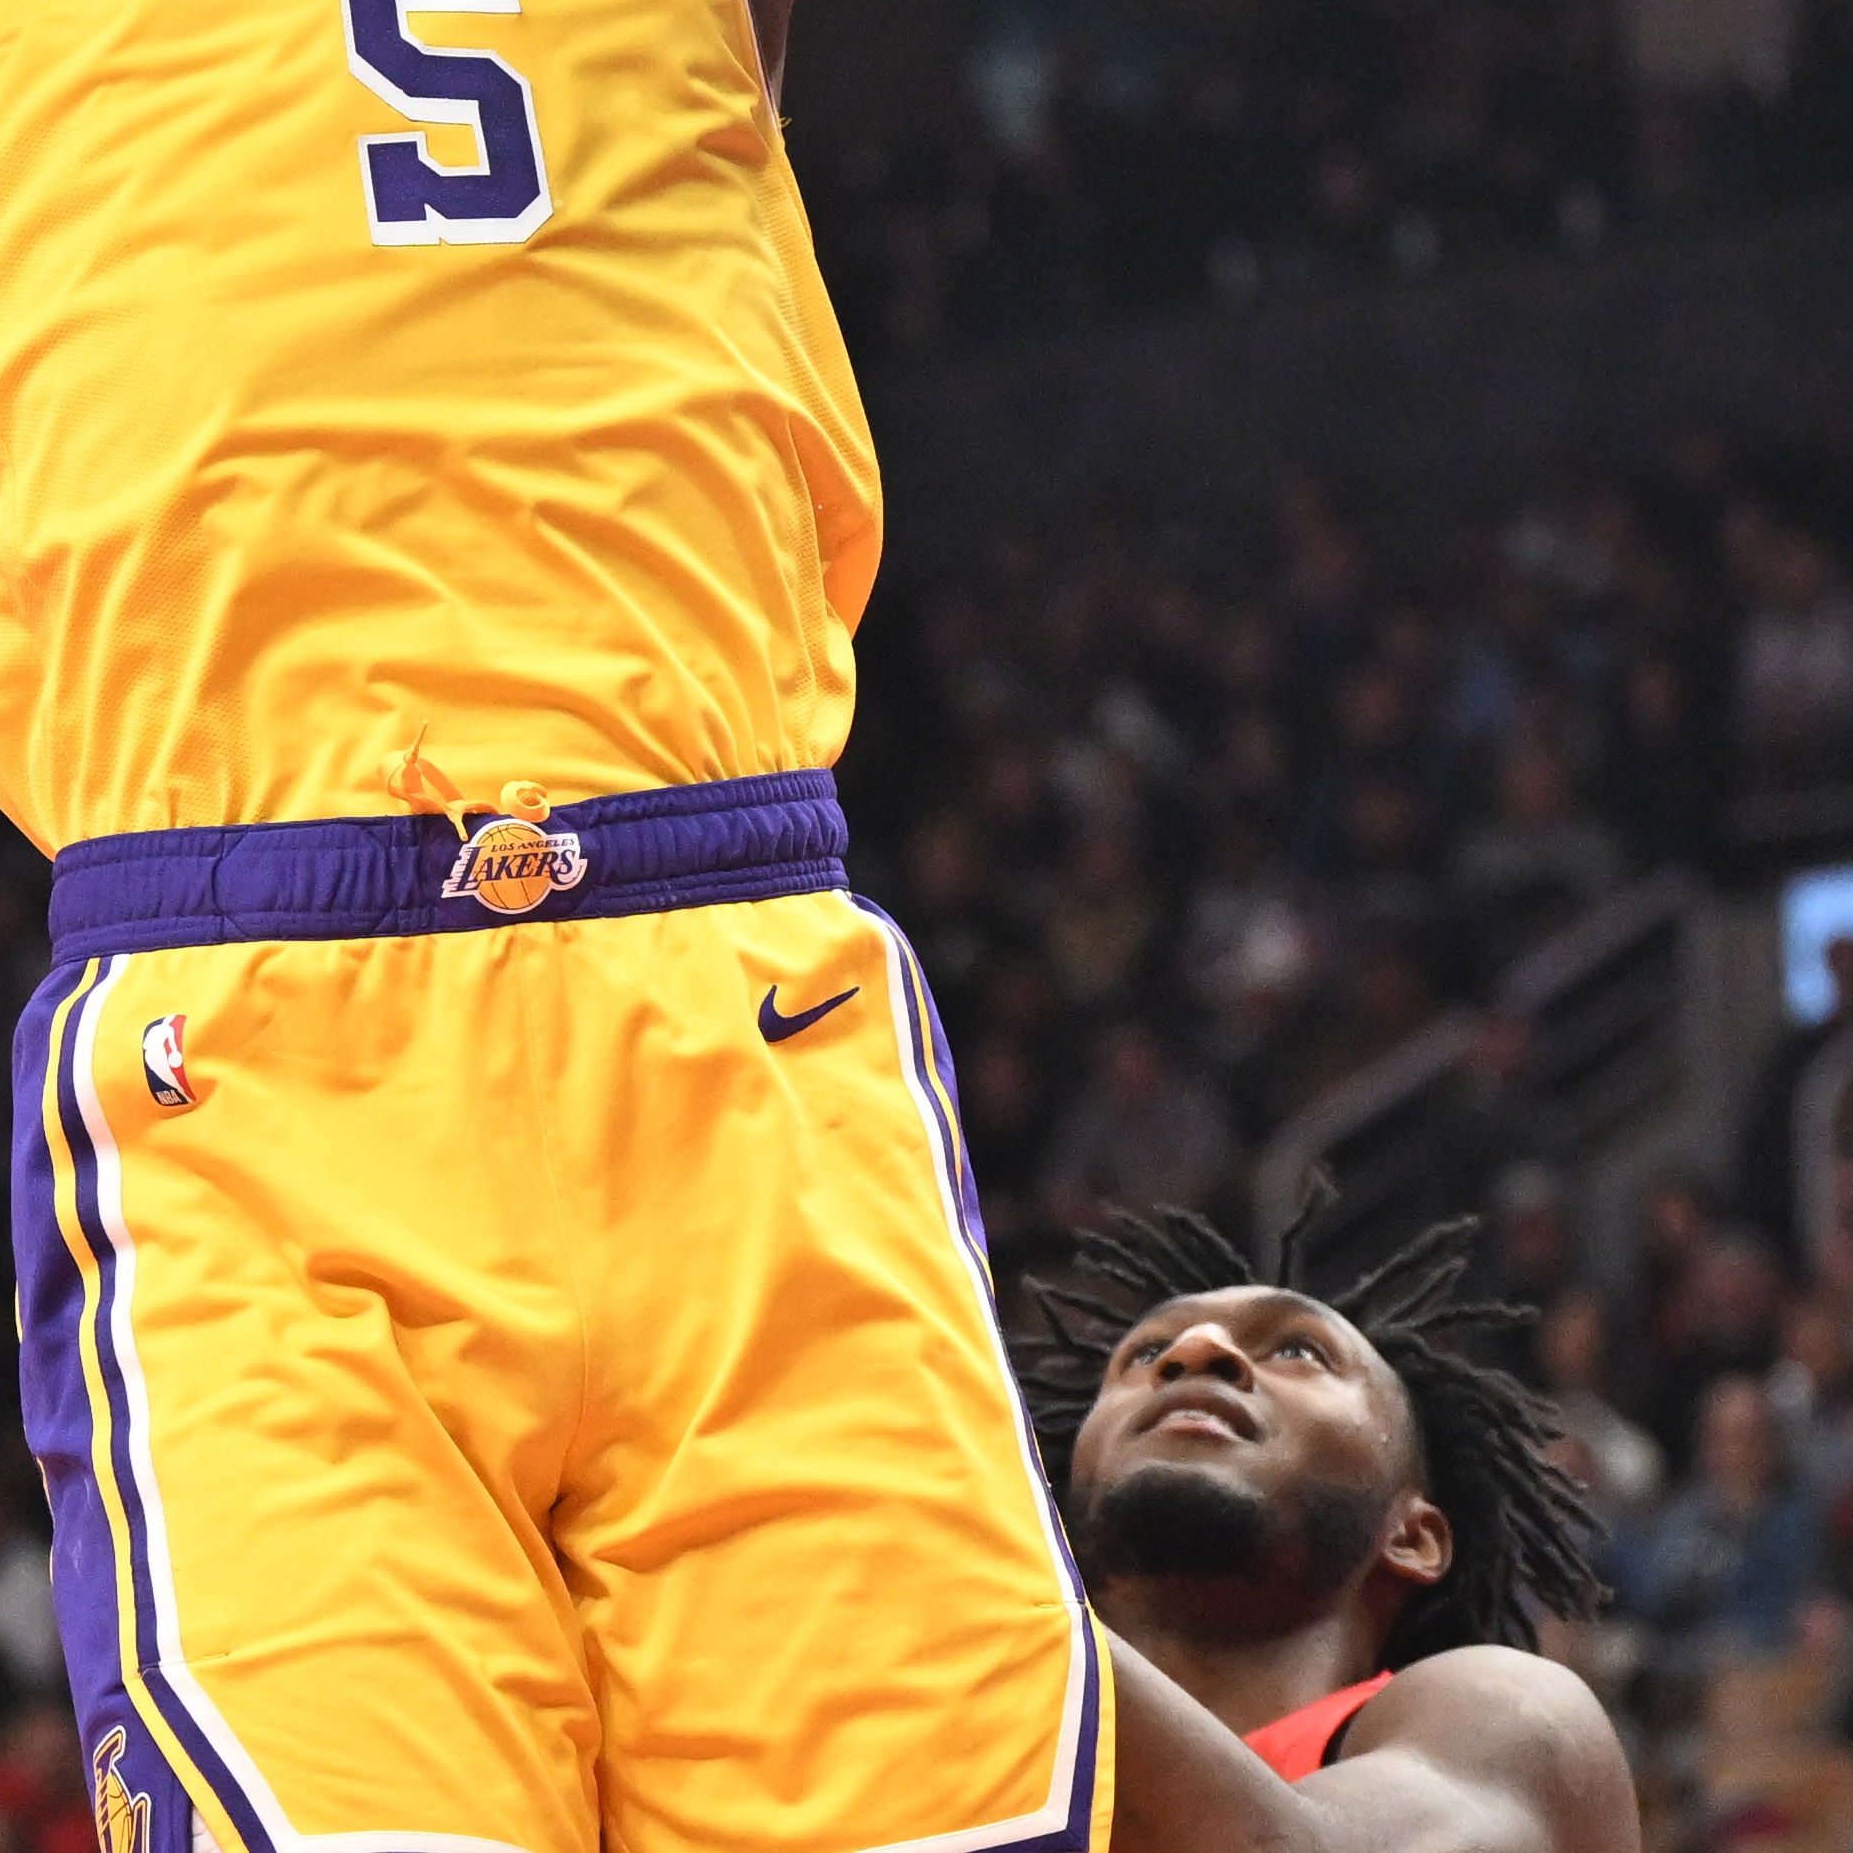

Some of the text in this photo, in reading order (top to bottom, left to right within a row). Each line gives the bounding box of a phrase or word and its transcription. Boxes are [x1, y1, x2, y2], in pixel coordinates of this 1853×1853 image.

[491, 837, 575, 853] LOS ANGELES
[448, 846, 583, 892] LAKERS
[155, 1089, 182, 1105] NBA
